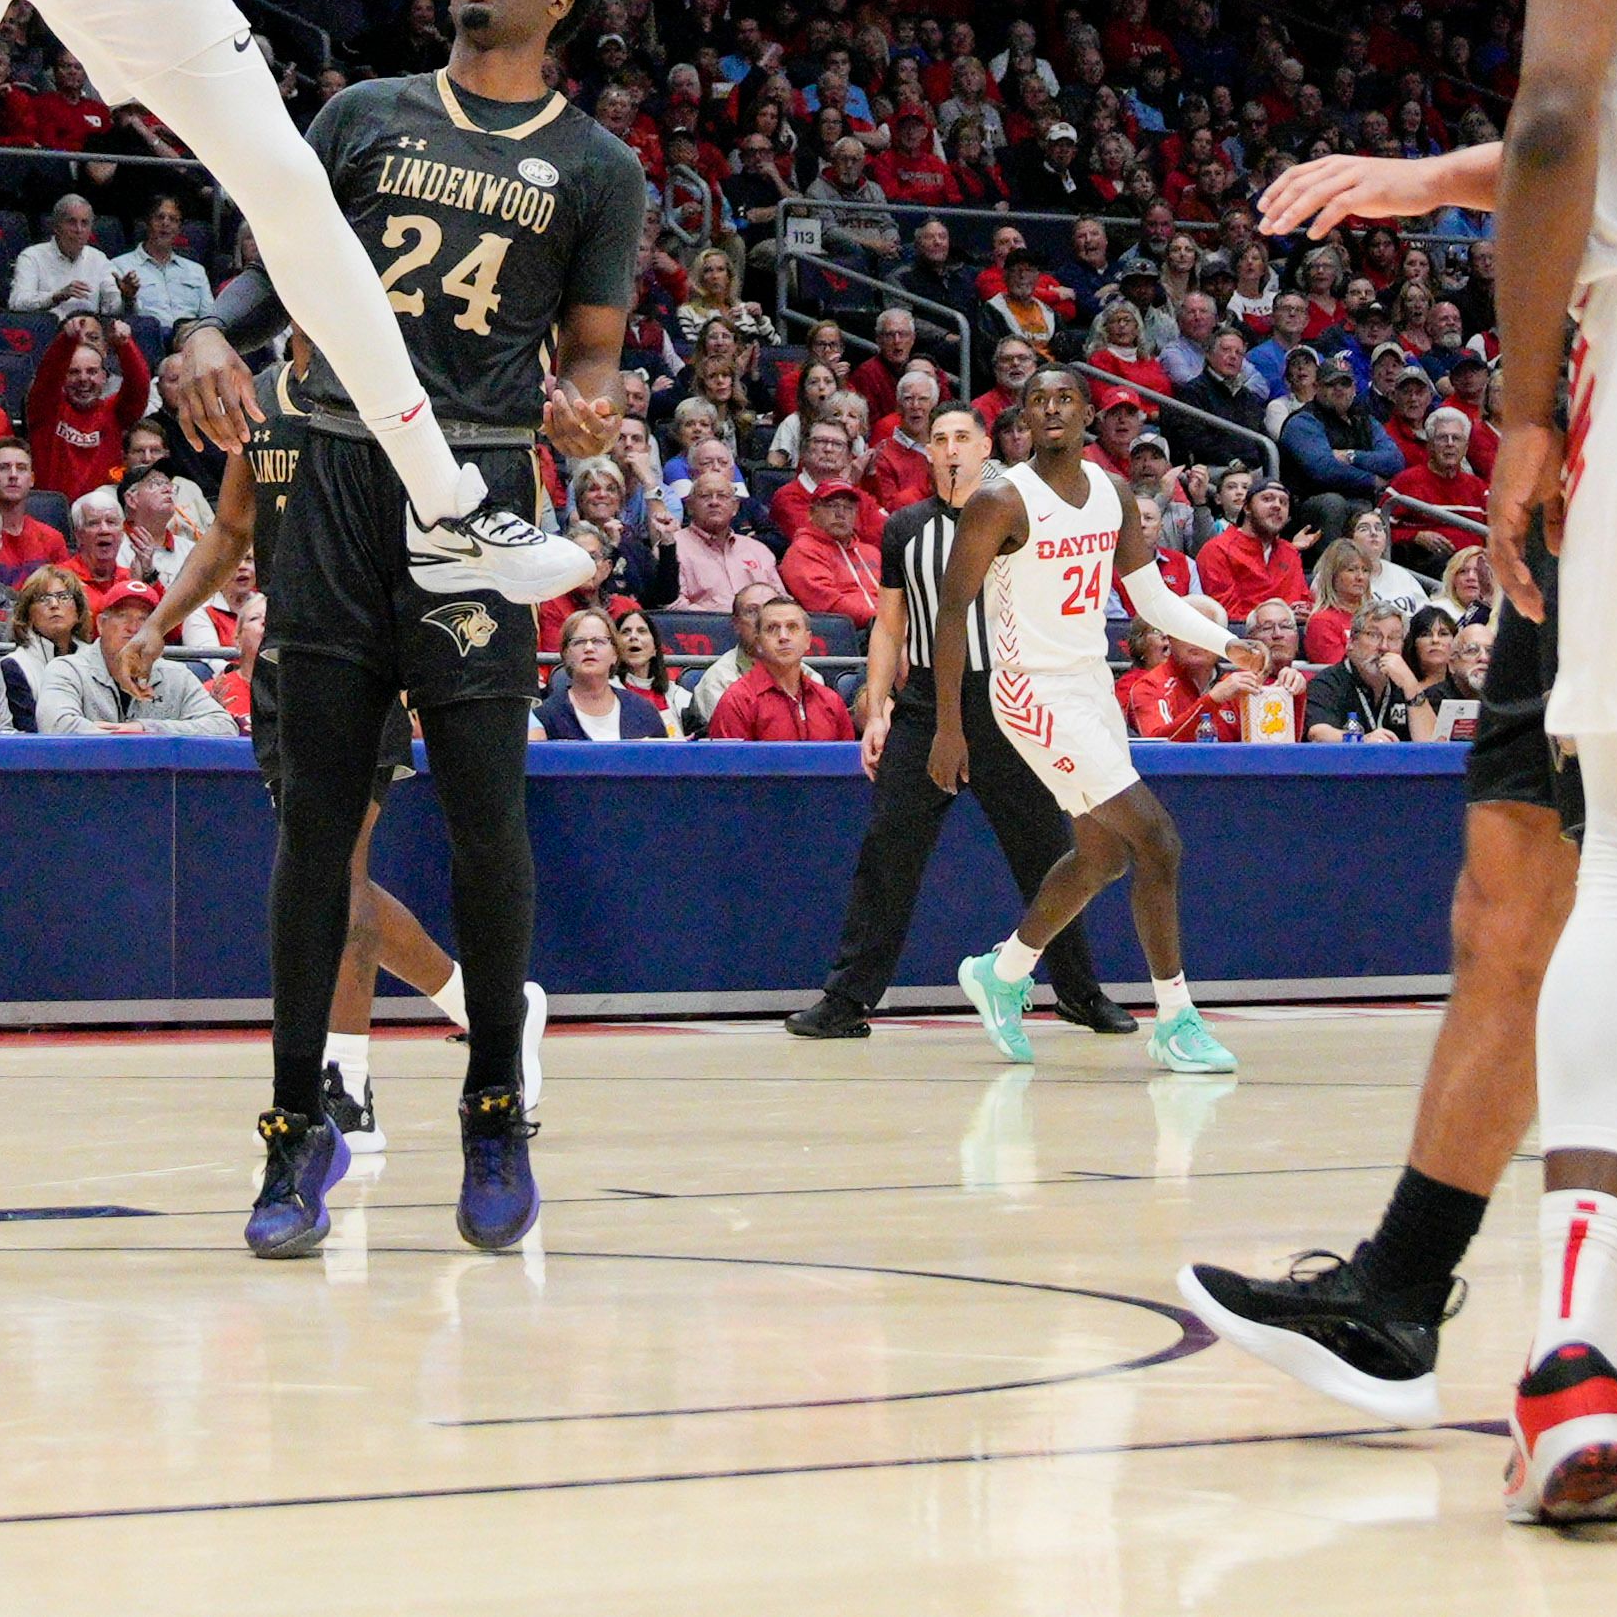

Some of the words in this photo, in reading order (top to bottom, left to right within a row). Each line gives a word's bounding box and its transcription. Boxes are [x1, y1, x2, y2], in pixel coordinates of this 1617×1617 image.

[376, 155, 557, 235] LINDENWOOD
[793, 231, 815, 245] 113
[379, 214, 514, 336] 24
[1035, 529, 1121, 560] DAYTON
[1061, 559, 1102, 616] 24
